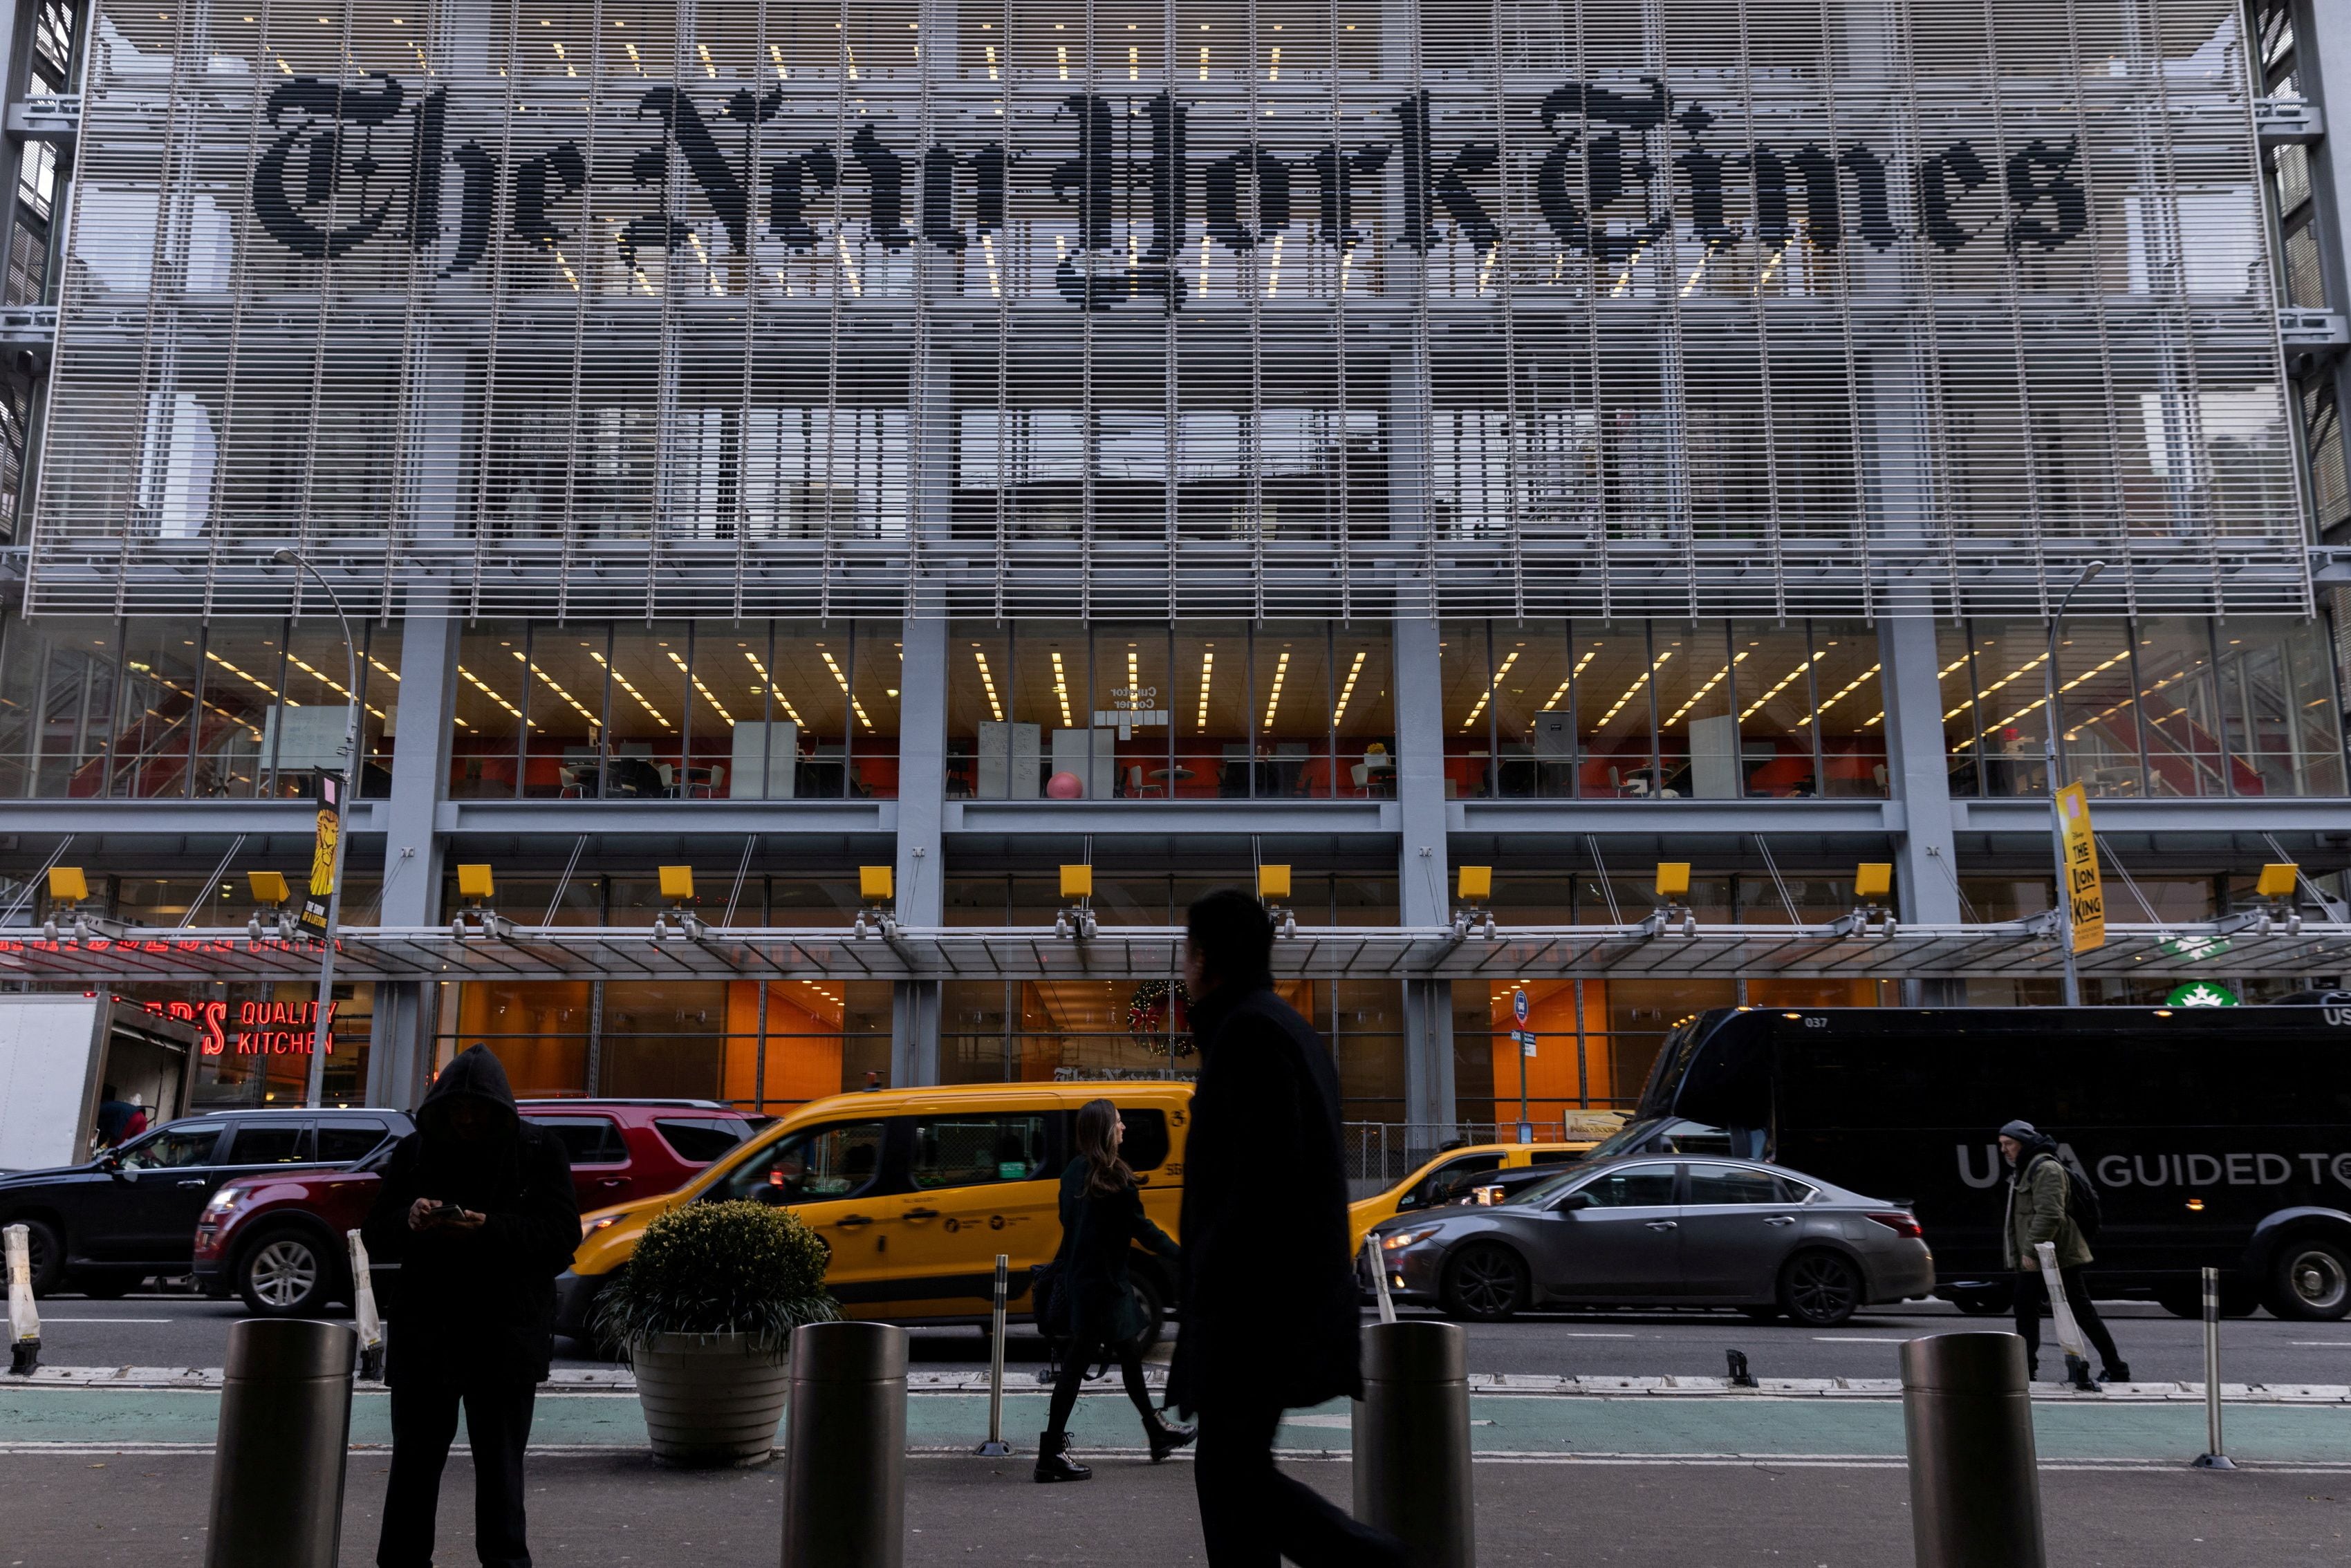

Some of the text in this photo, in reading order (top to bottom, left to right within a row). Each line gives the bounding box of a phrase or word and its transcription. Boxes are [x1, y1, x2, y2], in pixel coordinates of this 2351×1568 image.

[252, 72, 2088, 315] The New York Times
[2072, 841, 2089, 860] THE
[241, 1002, 338, 1025] QUALITY
[1805, 1018, 1828, 1027] 037
[238, 1032, 333, 1054] KITCHEN
[1957, 1144, 2090, 1188] UA
[2097, 1153, 2292, 1187] GUIDED
